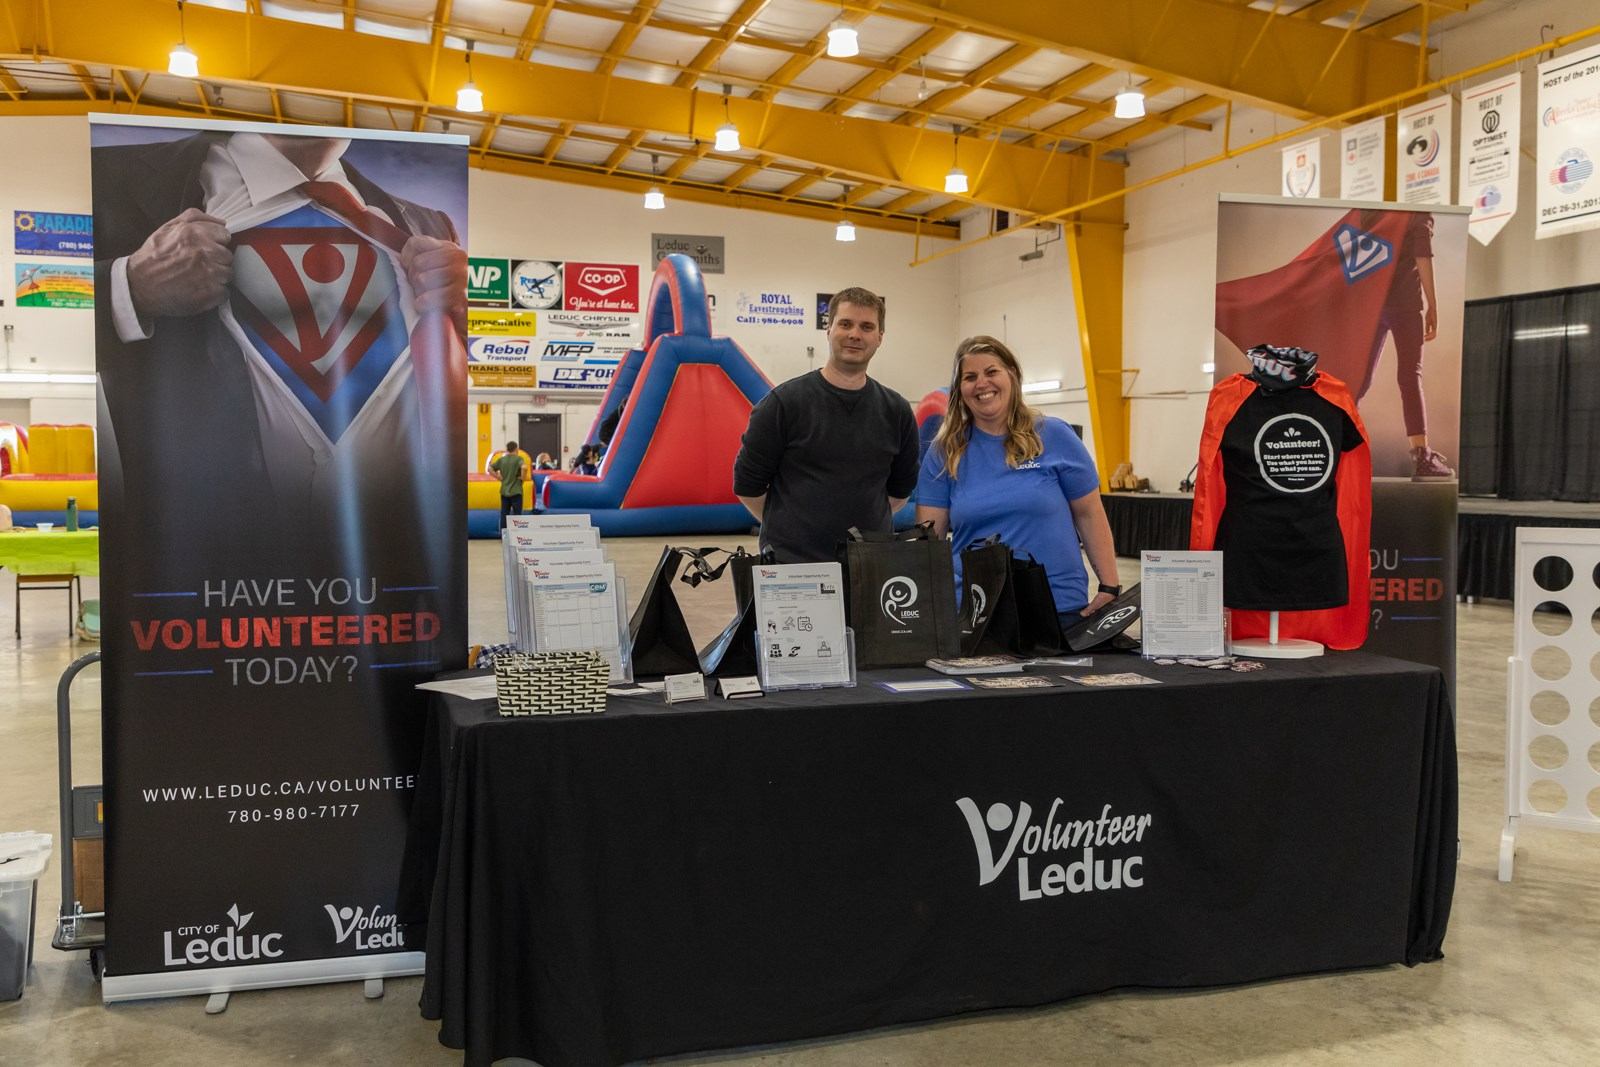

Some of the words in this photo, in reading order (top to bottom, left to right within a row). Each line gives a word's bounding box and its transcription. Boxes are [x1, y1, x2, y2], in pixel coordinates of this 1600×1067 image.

[1544, 76, 1561, 88] HOST
[1586, 65, 1600, 75] 201
[657, 239, 689, 251] Leduc
[657, 251, 720, 264] Gmiths
[584, 274, 621, 284] CO-OP
[761, 293, 792, 304] ROYAL
[749, 304, 804, 316] Eavestroughing
[483, 344, 530, 355] Rebel
[543, 344, 594, 356] MFP
[1265, 439, 1320, 449] Volunteer!
[204, 579, 296, 608] HAVE
[306, 577, 377, 605] YOU
[130, 612, 442, 650] VOLUNTEERED
[225, 655, 358, 686] TODAY?
[143, 775, 416, 802] WWW.LEDUC.CA/VOLUNTEE
[227, 804, 360, 823] 780-980-7177
[955, 797, 1152, 886] Volunteer
[1018, 847, 1144, 901] Leduc
[178, 926, 201, 936] CITY
[205, 924, 220, 935] OF
[324, 904, 400, 944] Volun
[163, 926, 284, 966] Leduc
